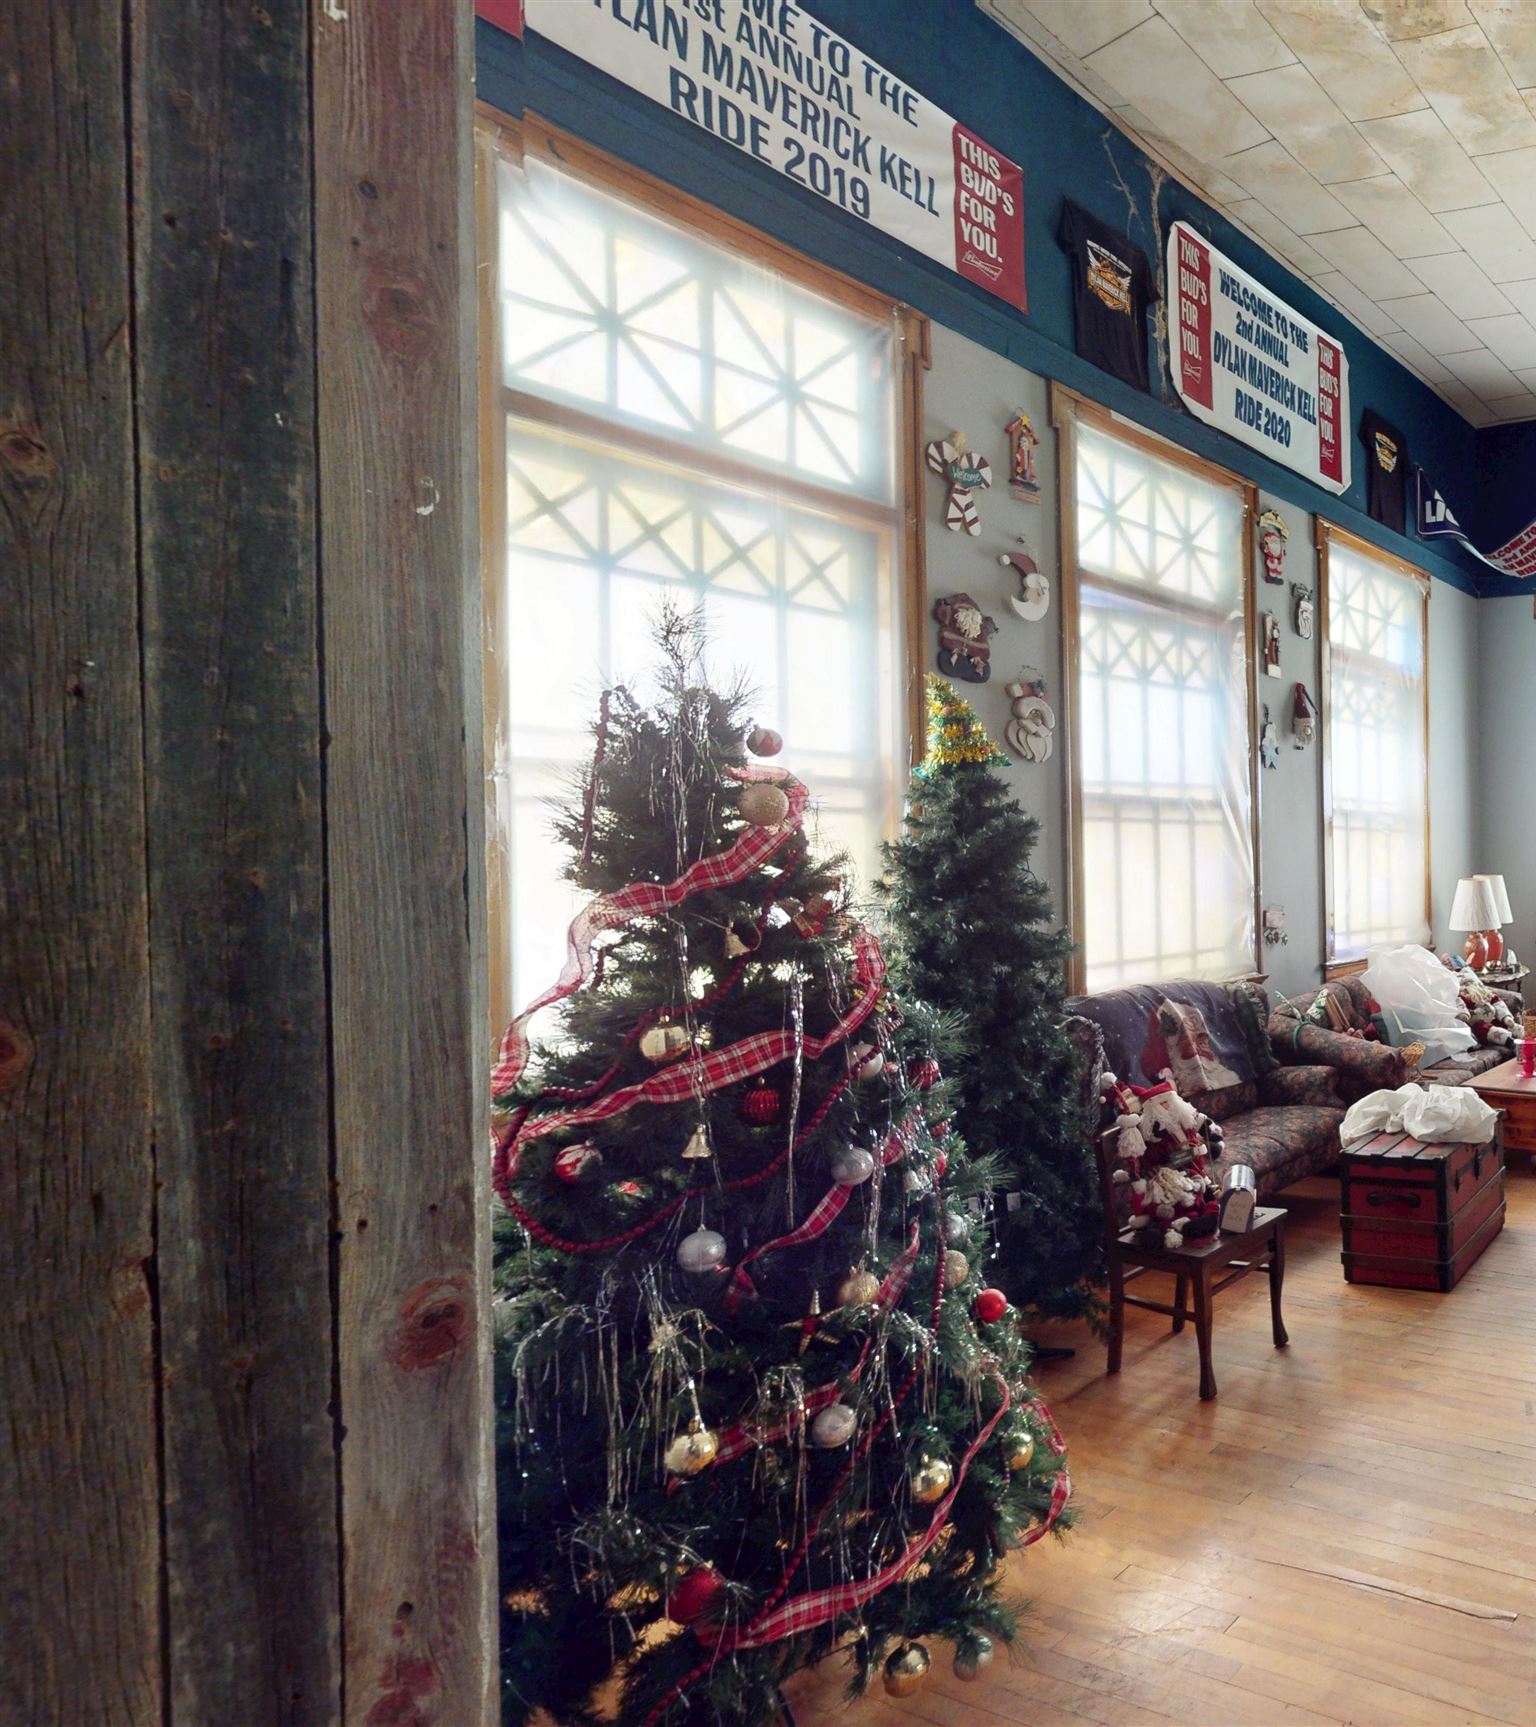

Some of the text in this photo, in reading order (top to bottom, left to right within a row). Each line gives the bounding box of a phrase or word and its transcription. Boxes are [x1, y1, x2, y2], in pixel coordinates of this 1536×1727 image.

[736, 12, 861, 121] ANNUAL
[810, 23, 851, 79] TO
[862, 60, 920, 128] THE
[669, 65, 871, 220] RIDE 2019
[702, 29, 872, 176] MAVERICK
[880, 144, 940, 218] KELL
[958, 132, 1002, 181] THIS
[960, 163, 1014, 217] BUD'S
[960, 189, 996, 233] FOR
[960, 216, 1003, 263] YOU.
[1180, 236, 1200, 272] THIS
[1181, 266, 1208, 306] BUD'S
[1181, 297, 1199, 330] FOR
[1219, 268, 1309, 354] WELCOME TO THE
[1182, 326, 1202, 361] YOU.
[1235, 311, 1289, 368] 2nd ANNUAL
[1319, 341, 1334, 370] THIS
[1213, 330, 1248, 382] DYLAN
[1248, 353, 1297, 413] MAVERICK
[1297, 386, 1317, 426] KELL
[1319, 366, 1339, 398] BUD'S
[1234, 387, 1291, 449] RIDE 2020
[1319, 392, 1334, 419] FOR
[1320, 416, 1335, 445] YOU.
